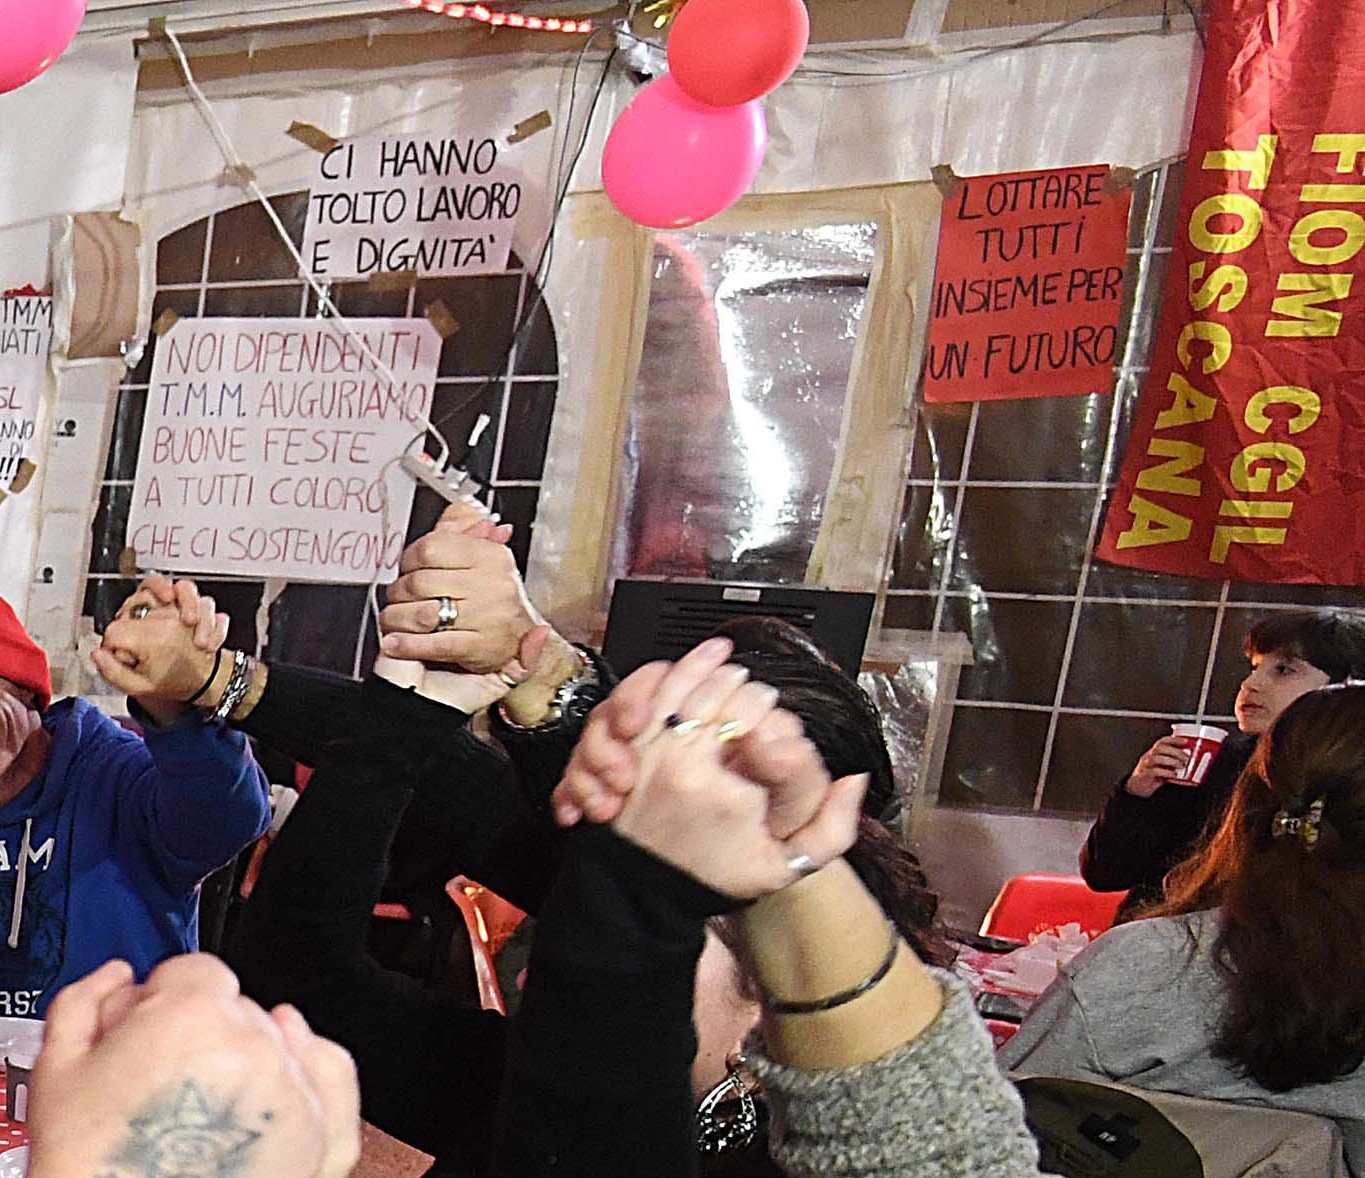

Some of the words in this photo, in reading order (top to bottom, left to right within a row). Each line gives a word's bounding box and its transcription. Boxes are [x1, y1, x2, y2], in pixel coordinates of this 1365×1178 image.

[321, 143, 354, 180] CI
[380, 138, 498, 177] HANNO
[312, 188, 407, 225] TOLTO
[416, 182, 521, 222] LAVORO
[957, 172, 1105, 220] LOTTARE
[312, 239, 331, 274] E
[1067, 266, 1124, 303] PER
[0, 296, 53, 328] TMM
[167, 332, 224, 375] NOI
[233, 330, 421, 374] DIPENDENTI
[929, 340, 969, 380] UN
[984, 324, 1118, 379] FUTURO
[1116, 134, 1279, 550] TOSCANA
[159, 382, 247, 417] T.M.M.
[256, 379, 428, 423] AUGURIAMO
[9, 441, 24, 458] DI
[153, 426, 246, 465] BUONE
[264, 427, 376, 466] FESTE
[144, 475, 162, 508] A
[178, 473, 254, 506] TUTTI
[270, 476, 387, 513] COLORO
[1209, 385, 1321, 565] CGIL
[131, 524, 184, 558] CHE
[190, 527, 219, 557] CI
[228, 526, 405, 571] SOSTENGONO
